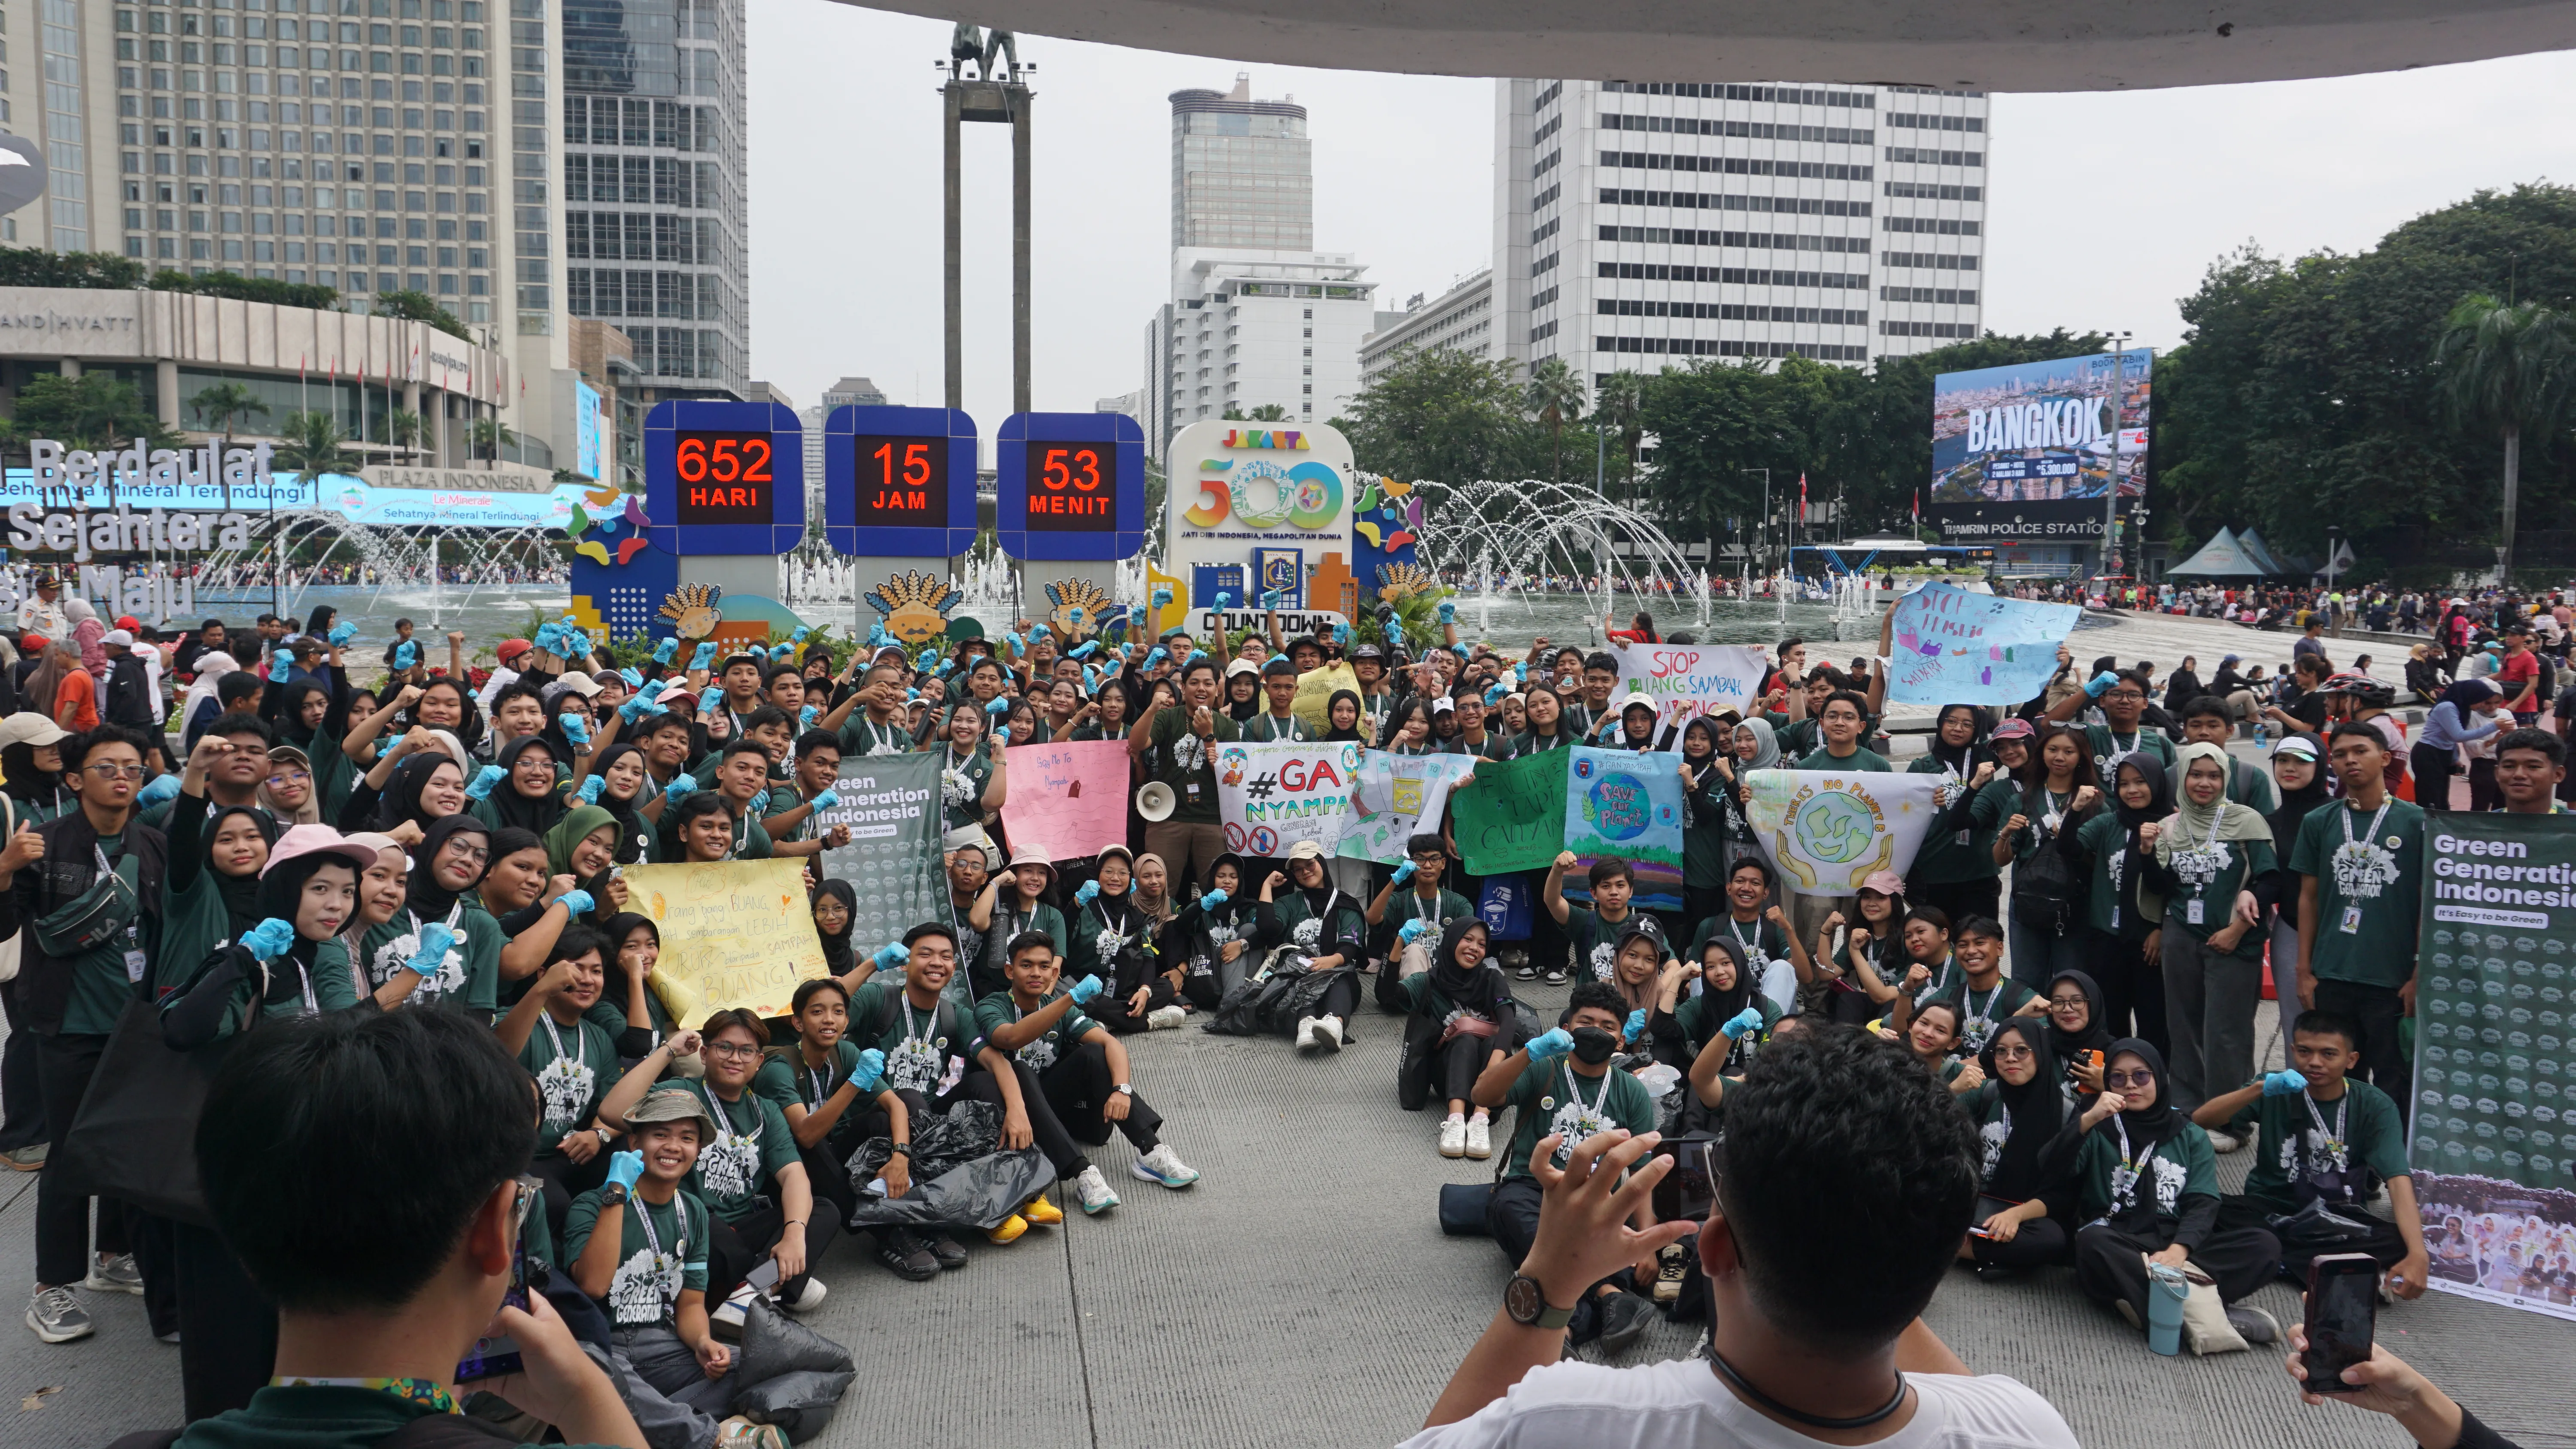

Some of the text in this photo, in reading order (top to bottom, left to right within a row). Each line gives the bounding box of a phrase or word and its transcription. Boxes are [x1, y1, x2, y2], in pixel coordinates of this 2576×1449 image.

[58, 316, 134, 332] HYATT
[2092, 354, 2145, 368] BOOKABIN
[1968, 397, 2105, 452] BANGKOK
[1222, 429, 1311, 450] JAKARTA
[30, 437, 274, 488] Berdaulat
[677, 439, 772, 482] 652
[875, 443, 930, 485] 15
[1043, 449, 1100, 491] 53
[380, 470, 537, 490] PLAZA INDONESIA
[190, 483, 305, 503] Terlndungi
[434, 494, 490, 506] Le Minerale
[691, 488, 756, 506] HARI
[873, 492, 925, 510] JAM
[1183, 458, 1343, 529] 500
[384, 509, 539, 522] Sehatnya Mineral Terlindungi
[1030, 496, 1109, 515] MENIT
[8, 501, 251, 562] Sejahtera
[1218, 532, 1261, 540] INDONESIA,
[1944, 524, 1989, 535] THAMRIN
[1992, 524, 2042, 534] POLICE
[79, 564, 197, 627] Maju
[1916, 586, 1973, 615] STOP
[1650, 651, 1700, 678] STOP
[1628, 675, 1743, 696] BUANG SAMPAH
[1063, 752, 1071, 763] To
[832, 776, 876, 791] reen
[1600, 782, 1638, 802] SAVE
[836, 787, 930, 807] eneration
[1784, 785, 1814, 826] THERE'S
[1823, 779, 1844, 791] NO
[1849, 782, 1884, 823] PLANET
[820, 804, 920, 824] Indonesia
[1280, 819, 1316, 832] GENERASI
[2434, 834, 2527, 858] Green
[651, 890, 767, 925] Orang yang BUANG
[2438, 909, 2454, 918] It's
[2456, 910, 2480, 921] Easy
[2495, 914, 2508, 922] be
[2511, 915, 2543, 925] Green
[78, 918, 118, 949] FILA
[659, 915, 789, 941] PAH sembarangan LEBIH
[766, 934, 814, 957] SAMPAH
[702, 966, 784, 1013] BUANG
[547, 1021, 559, 1043] GENERATION
[633, 1194, 659, 1258] GREEN GENERATION INDONESIA
[621, 1281, 662, 1305] GREEN
[617, 1303, 662, 1323] GENERATION
